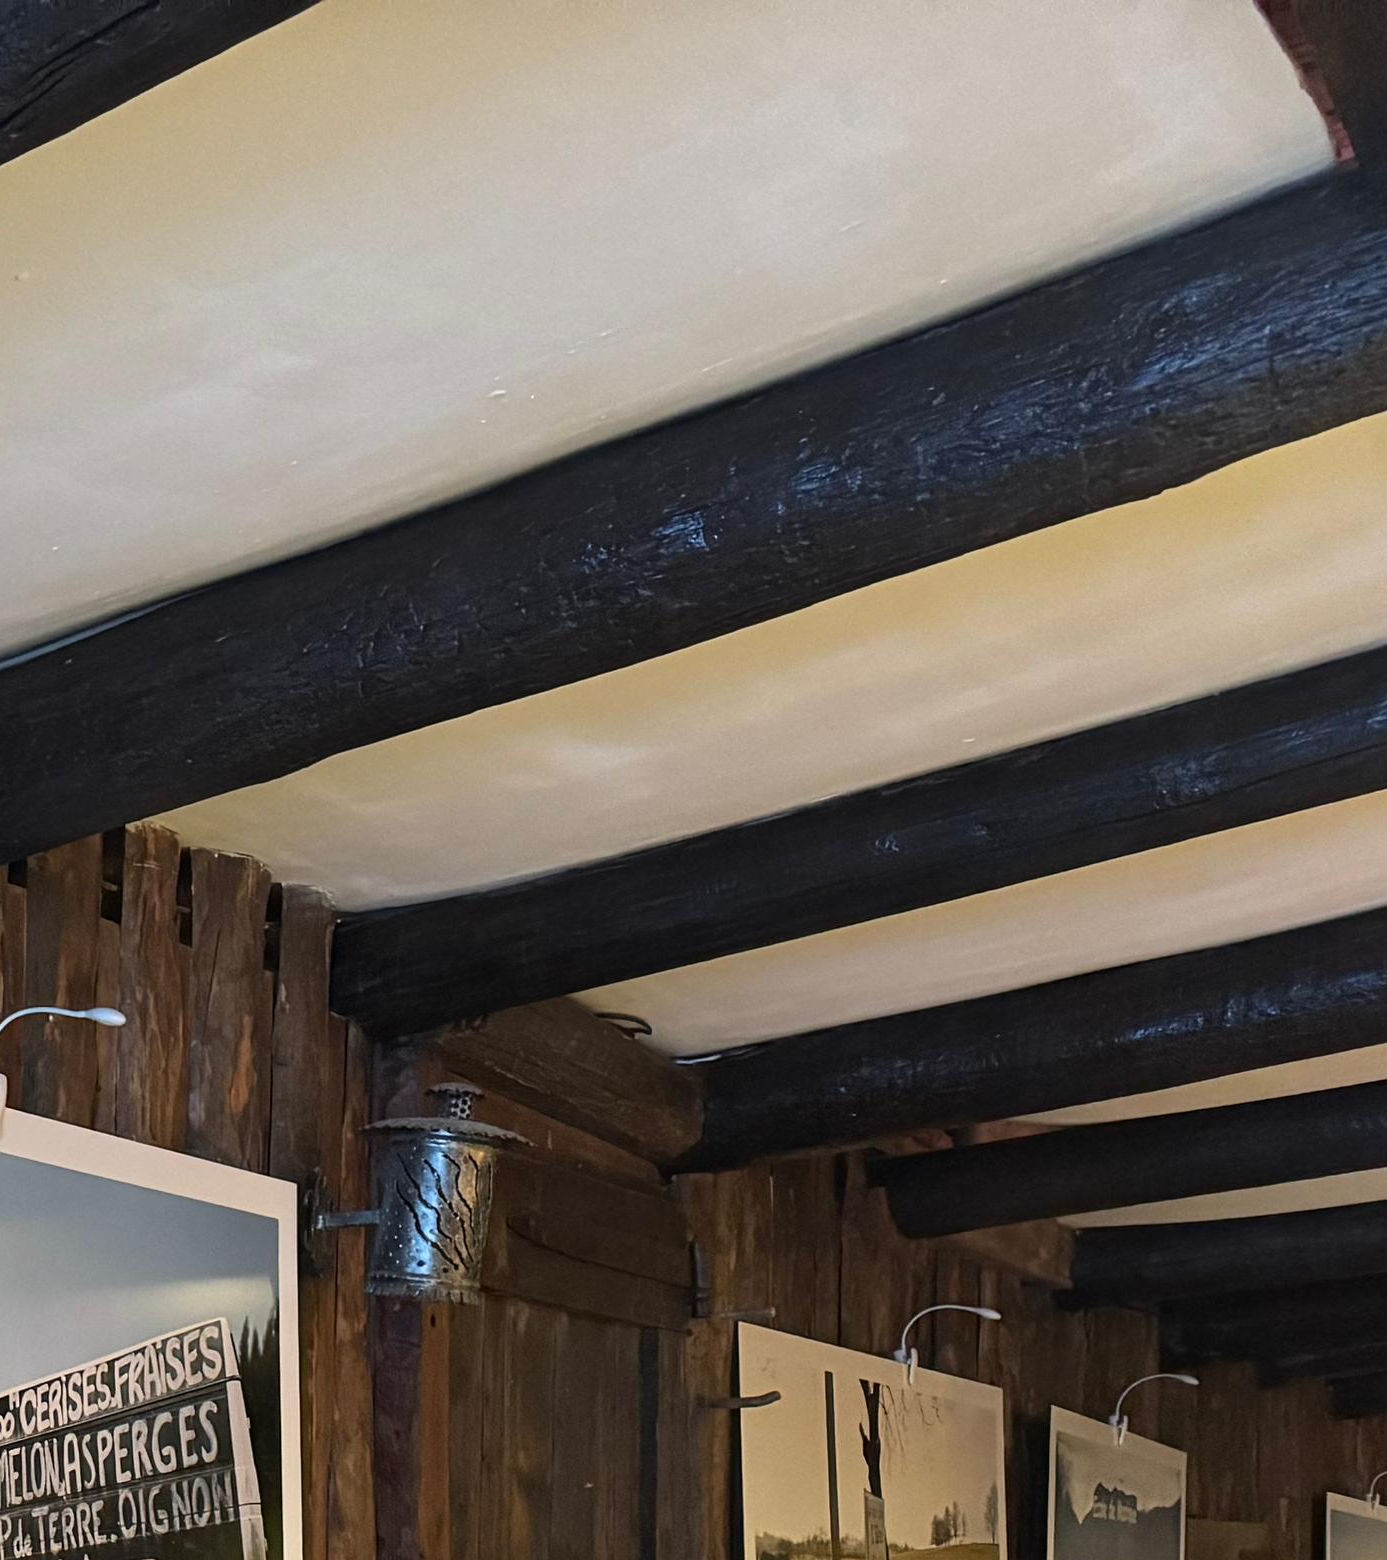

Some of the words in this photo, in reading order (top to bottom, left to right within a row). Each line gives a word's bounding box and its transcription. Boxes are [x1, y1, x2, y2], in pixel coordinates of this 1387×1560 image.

[0, 1516, 12, 1560] P
[13, 1519, 33, 1558] de
[118, 1472, 235, 1539] OIGNON
